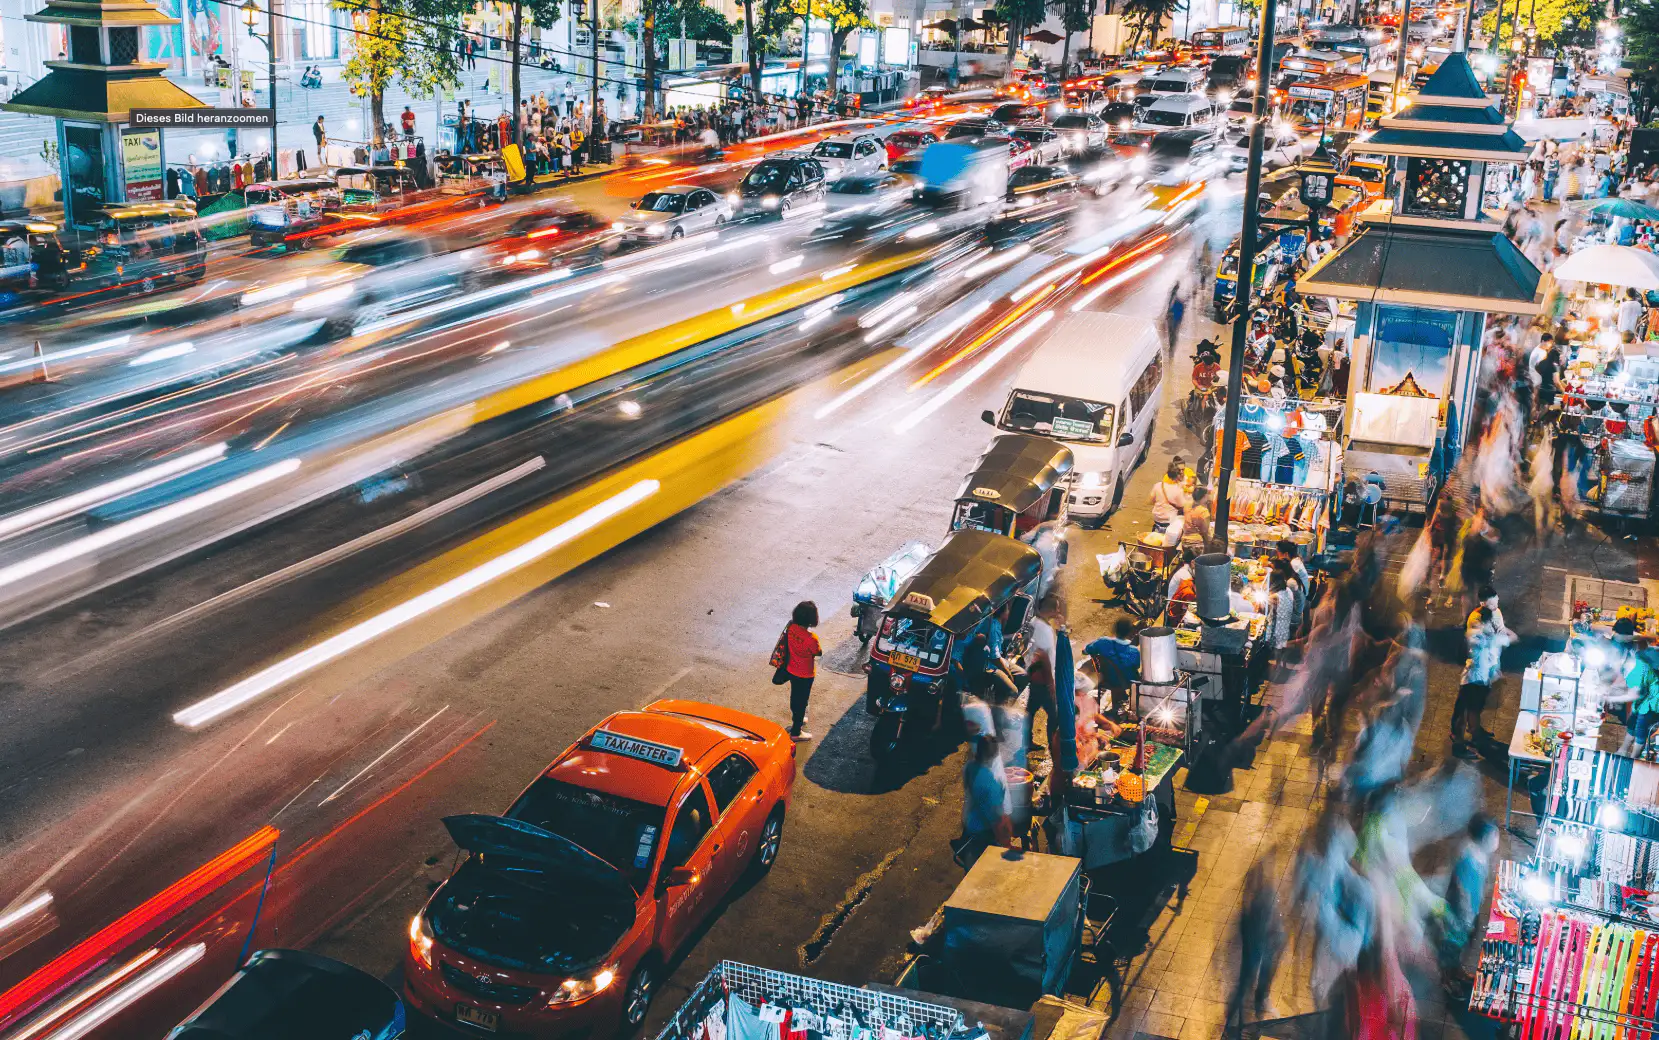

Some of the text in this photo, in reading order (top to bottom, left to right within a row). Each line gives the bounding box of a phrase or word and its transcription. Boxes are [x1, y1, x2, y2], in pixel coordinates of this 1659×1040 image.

[123, 137, 141, 147] TAXI
[910, 595, 928, 606] TAXI
[904, 655, 917, 666] 573
[603, 735, 668, 761] TAXI-METER
[1569, 761, 1589, 776] 50
